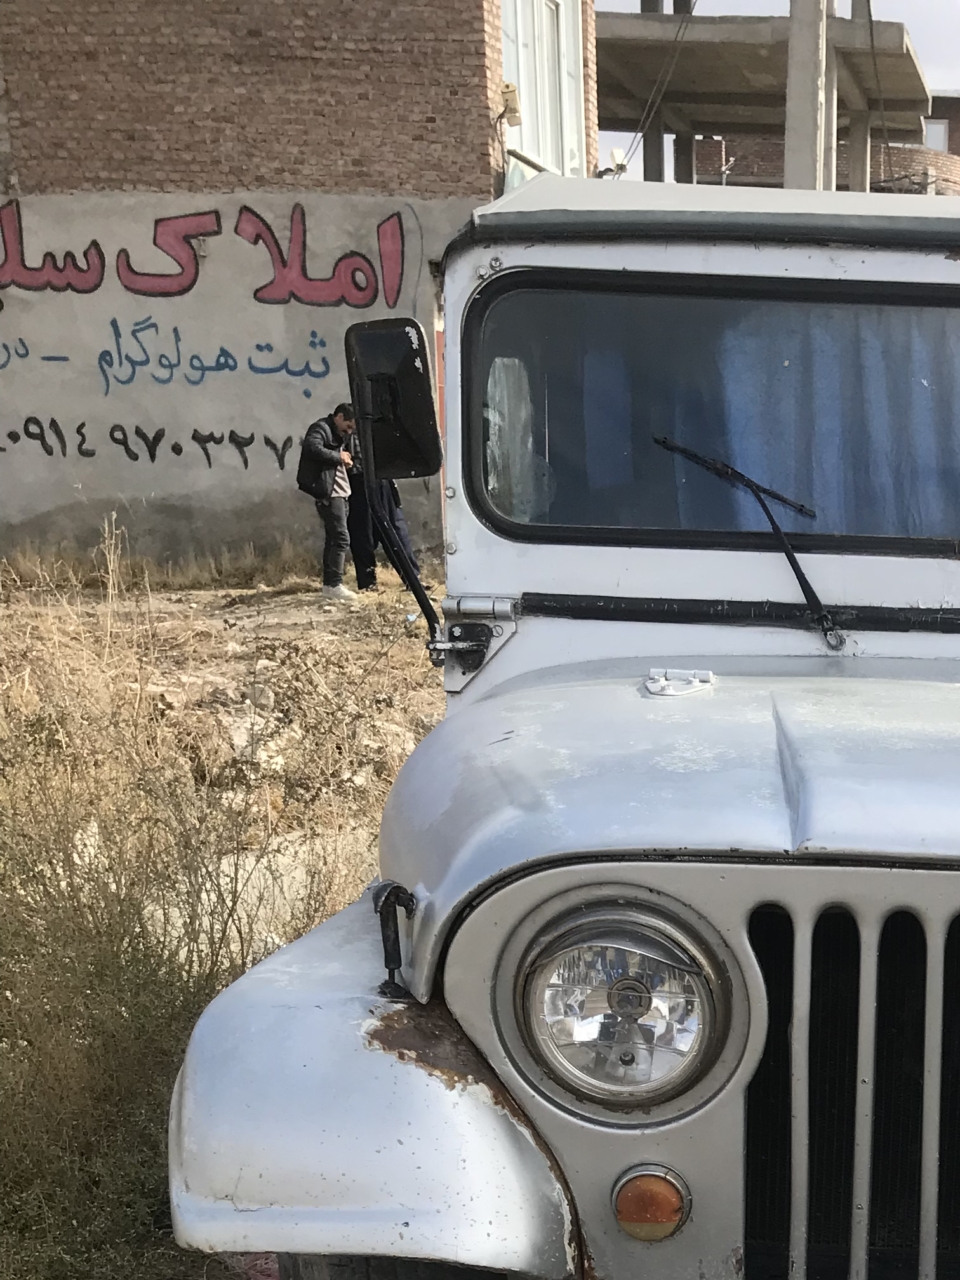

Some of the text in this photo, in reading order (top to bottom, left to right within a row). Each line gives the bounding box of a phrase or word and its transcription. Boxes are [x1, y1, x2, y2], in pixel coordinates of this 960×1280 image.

[0, 198, 406, 309] املاک سل
[98, 316, 238, 396] هولوگرام
[248, 330, 330, 399] ثبت
[109, 423, 303, 471] ۹۷۰۳۲۷
